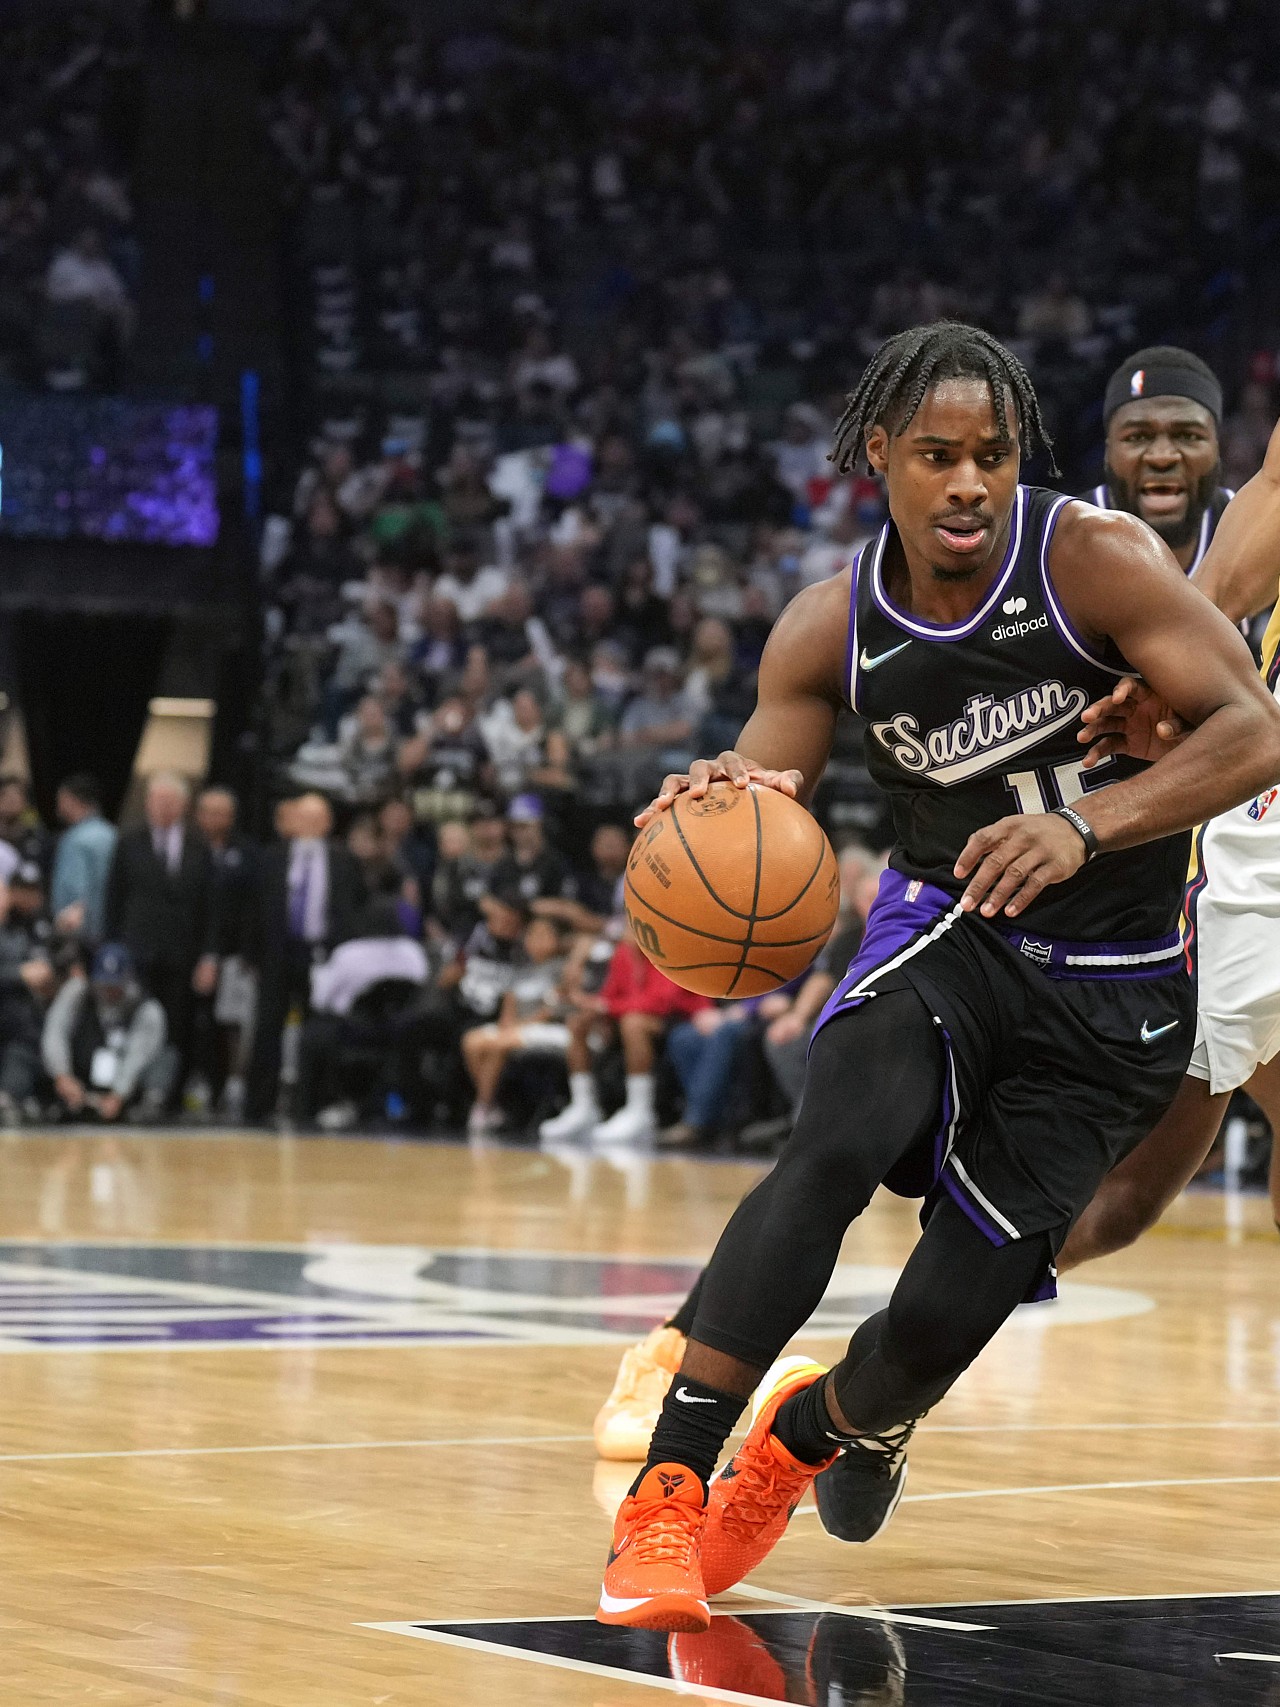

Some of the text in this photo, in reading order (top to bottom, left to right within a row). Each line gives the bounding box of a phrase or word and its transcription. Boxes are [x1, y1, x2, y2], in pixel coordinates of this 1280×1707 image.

[991, 612, 1049, 641] dialpad
[870, 679, 1088, 776] Sactown
[1060, 807, 1091, 835] Blessed
